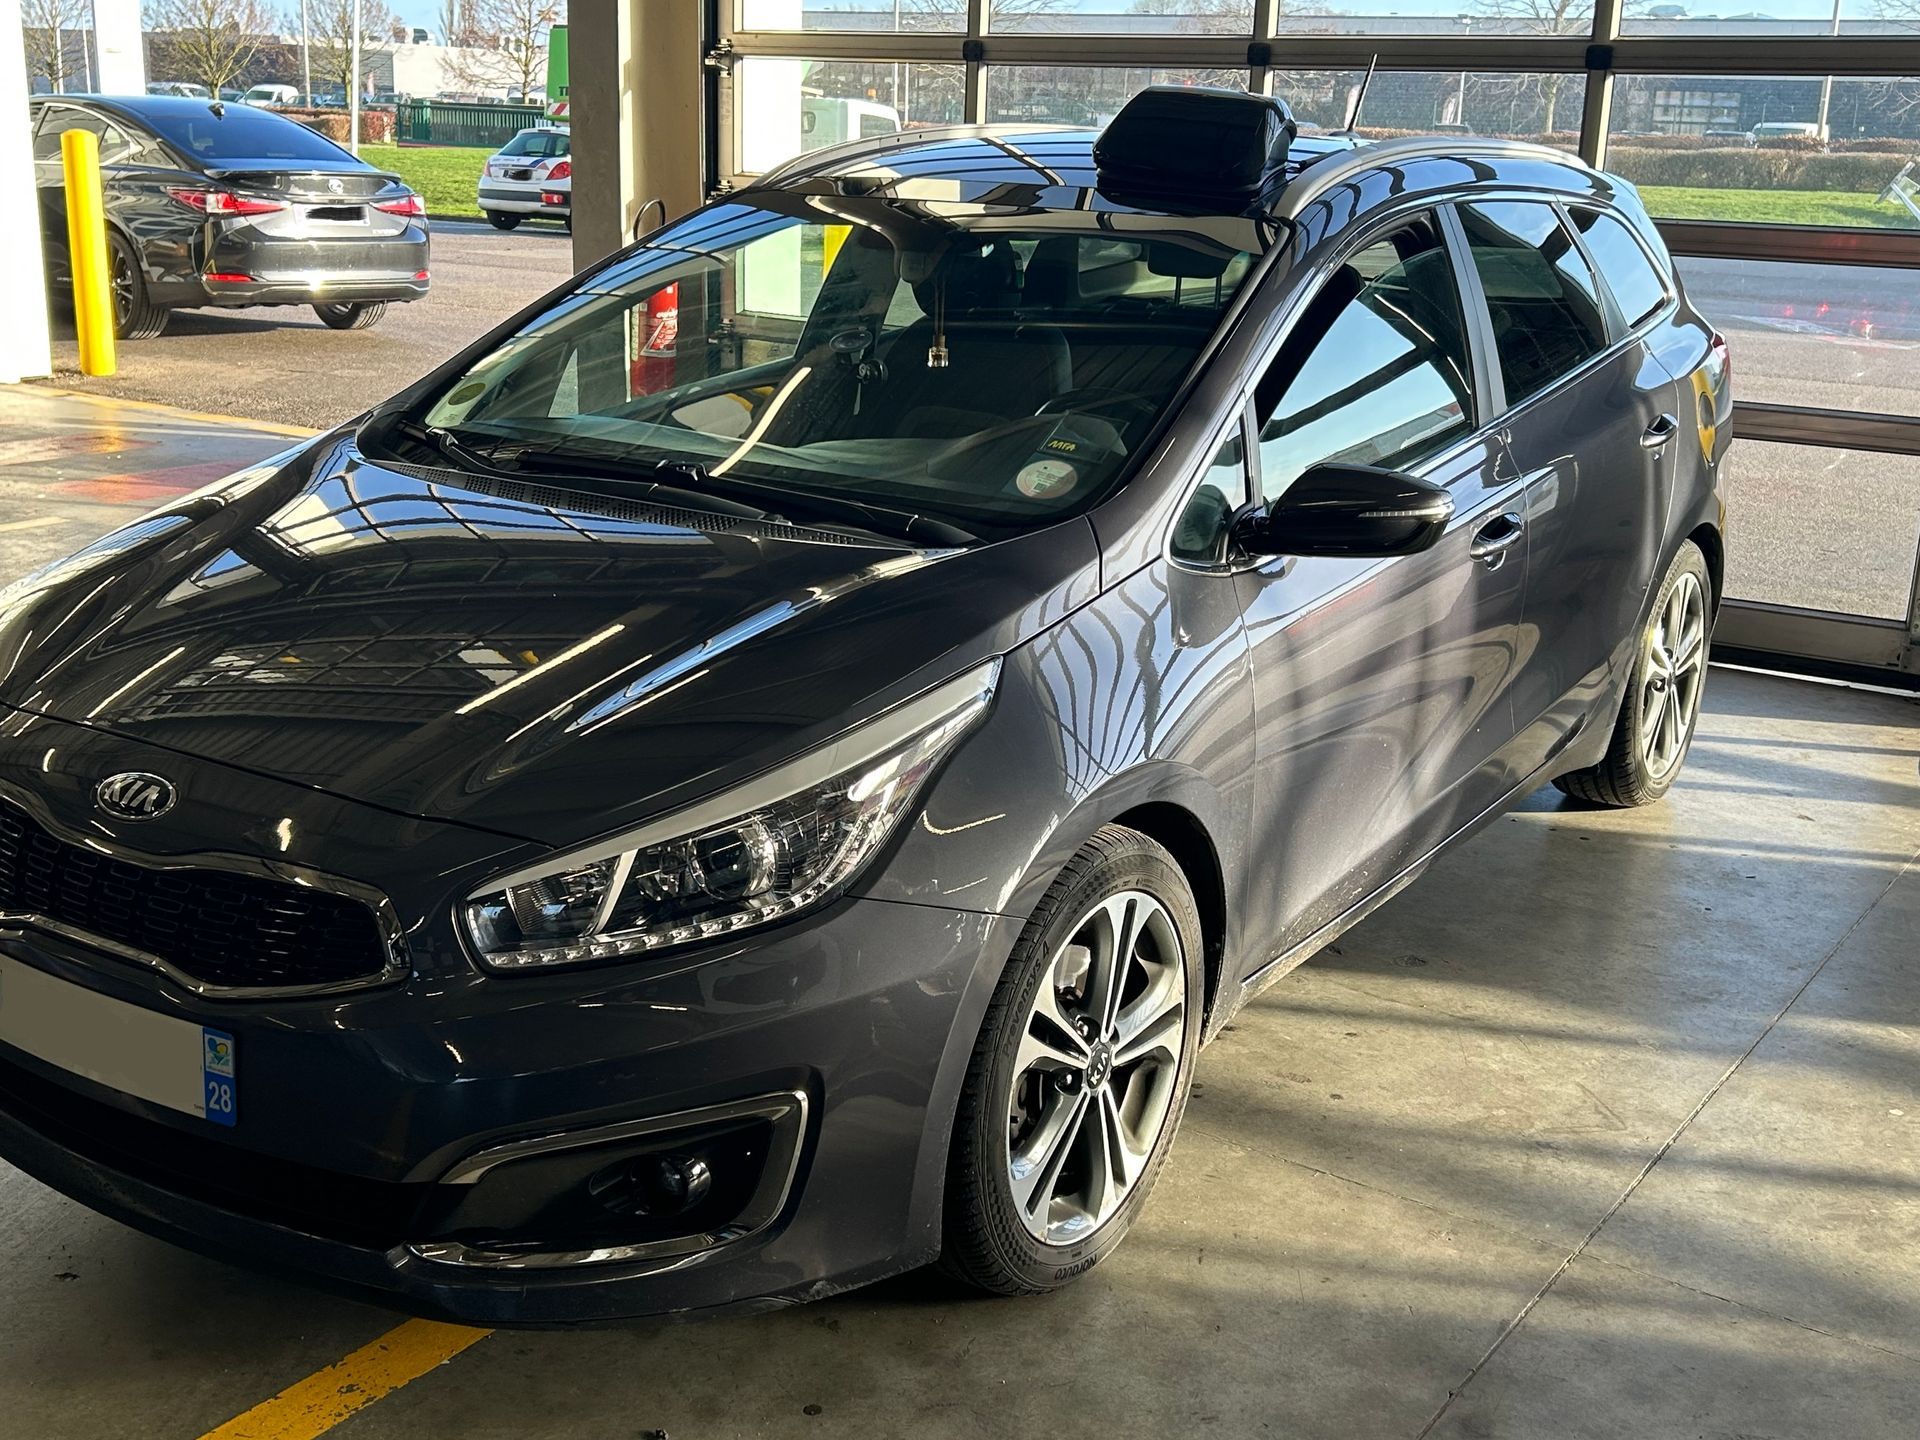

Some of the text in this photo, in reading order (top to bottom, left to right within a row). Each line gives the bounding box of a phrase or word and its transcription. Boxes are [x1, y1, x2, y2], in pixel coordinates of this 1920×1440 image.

[103, 776, 161, 812] KIA
[1001, 940, 1051, 1058] Prevensys 4
[1090, 1052, 1109, 1086] KIA
[208, 1081, 232, 1113] 28
[1054, 1254, 1098, 1281] Norauto
